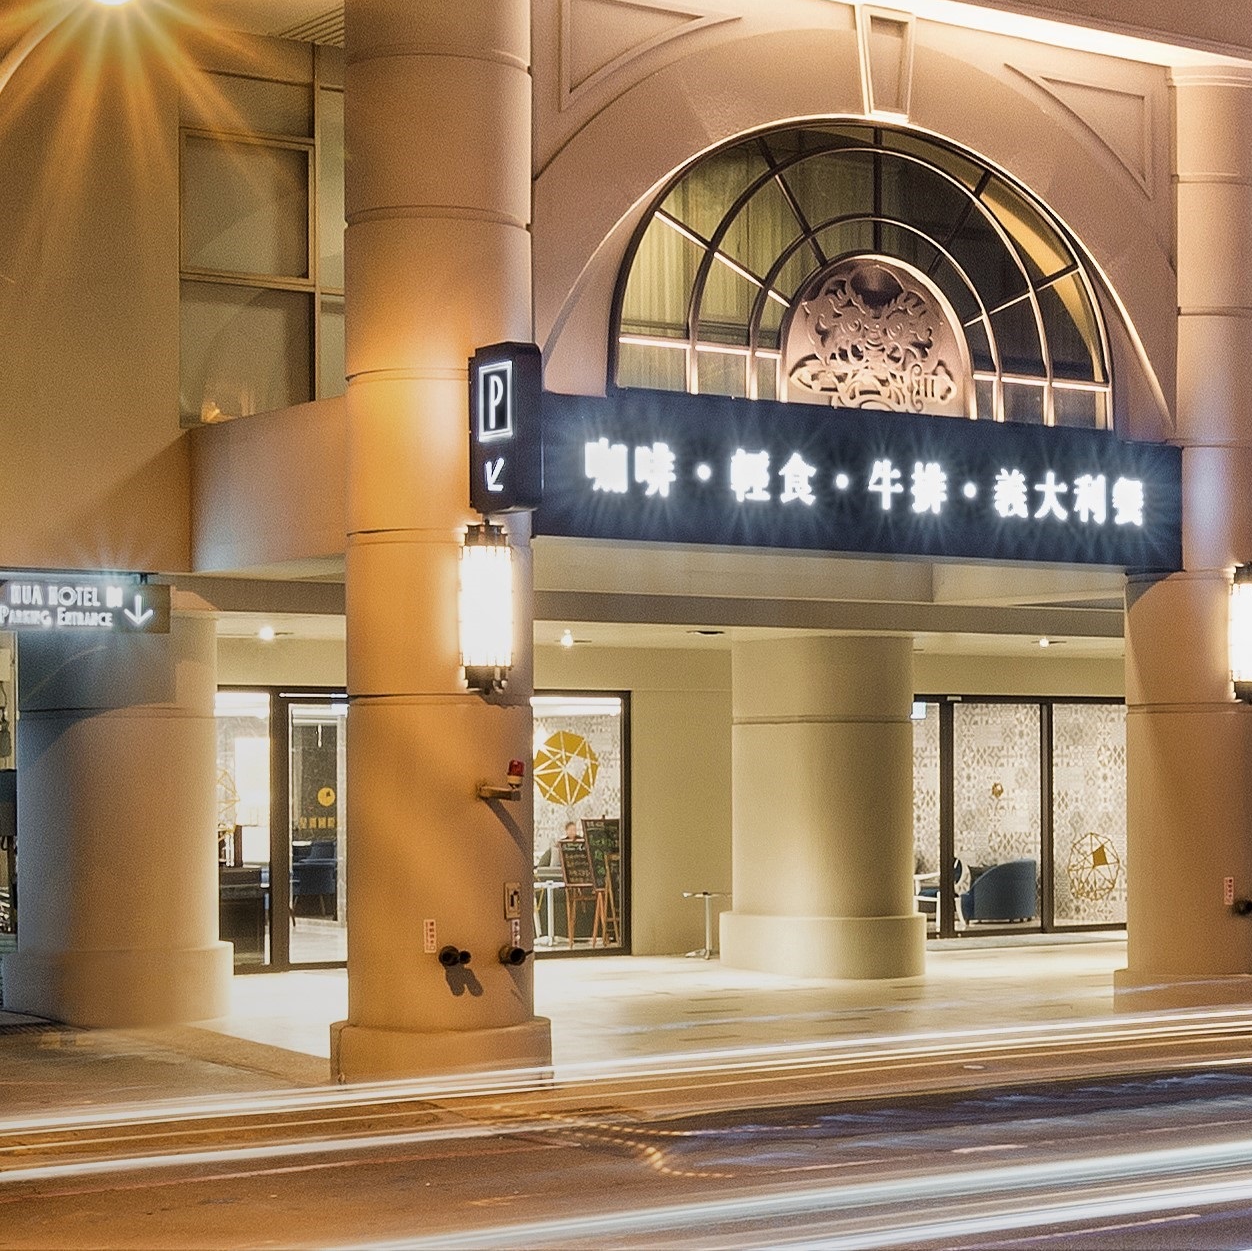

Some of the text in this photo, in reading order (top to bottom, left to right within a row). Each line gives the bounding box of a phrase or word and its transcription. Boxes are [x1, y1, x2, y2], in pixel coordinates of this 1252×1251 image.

[488, 374, 504, 430] P
[10, 584, 43, 606] HUA
[48, 585, 101, 607] HOTEL
